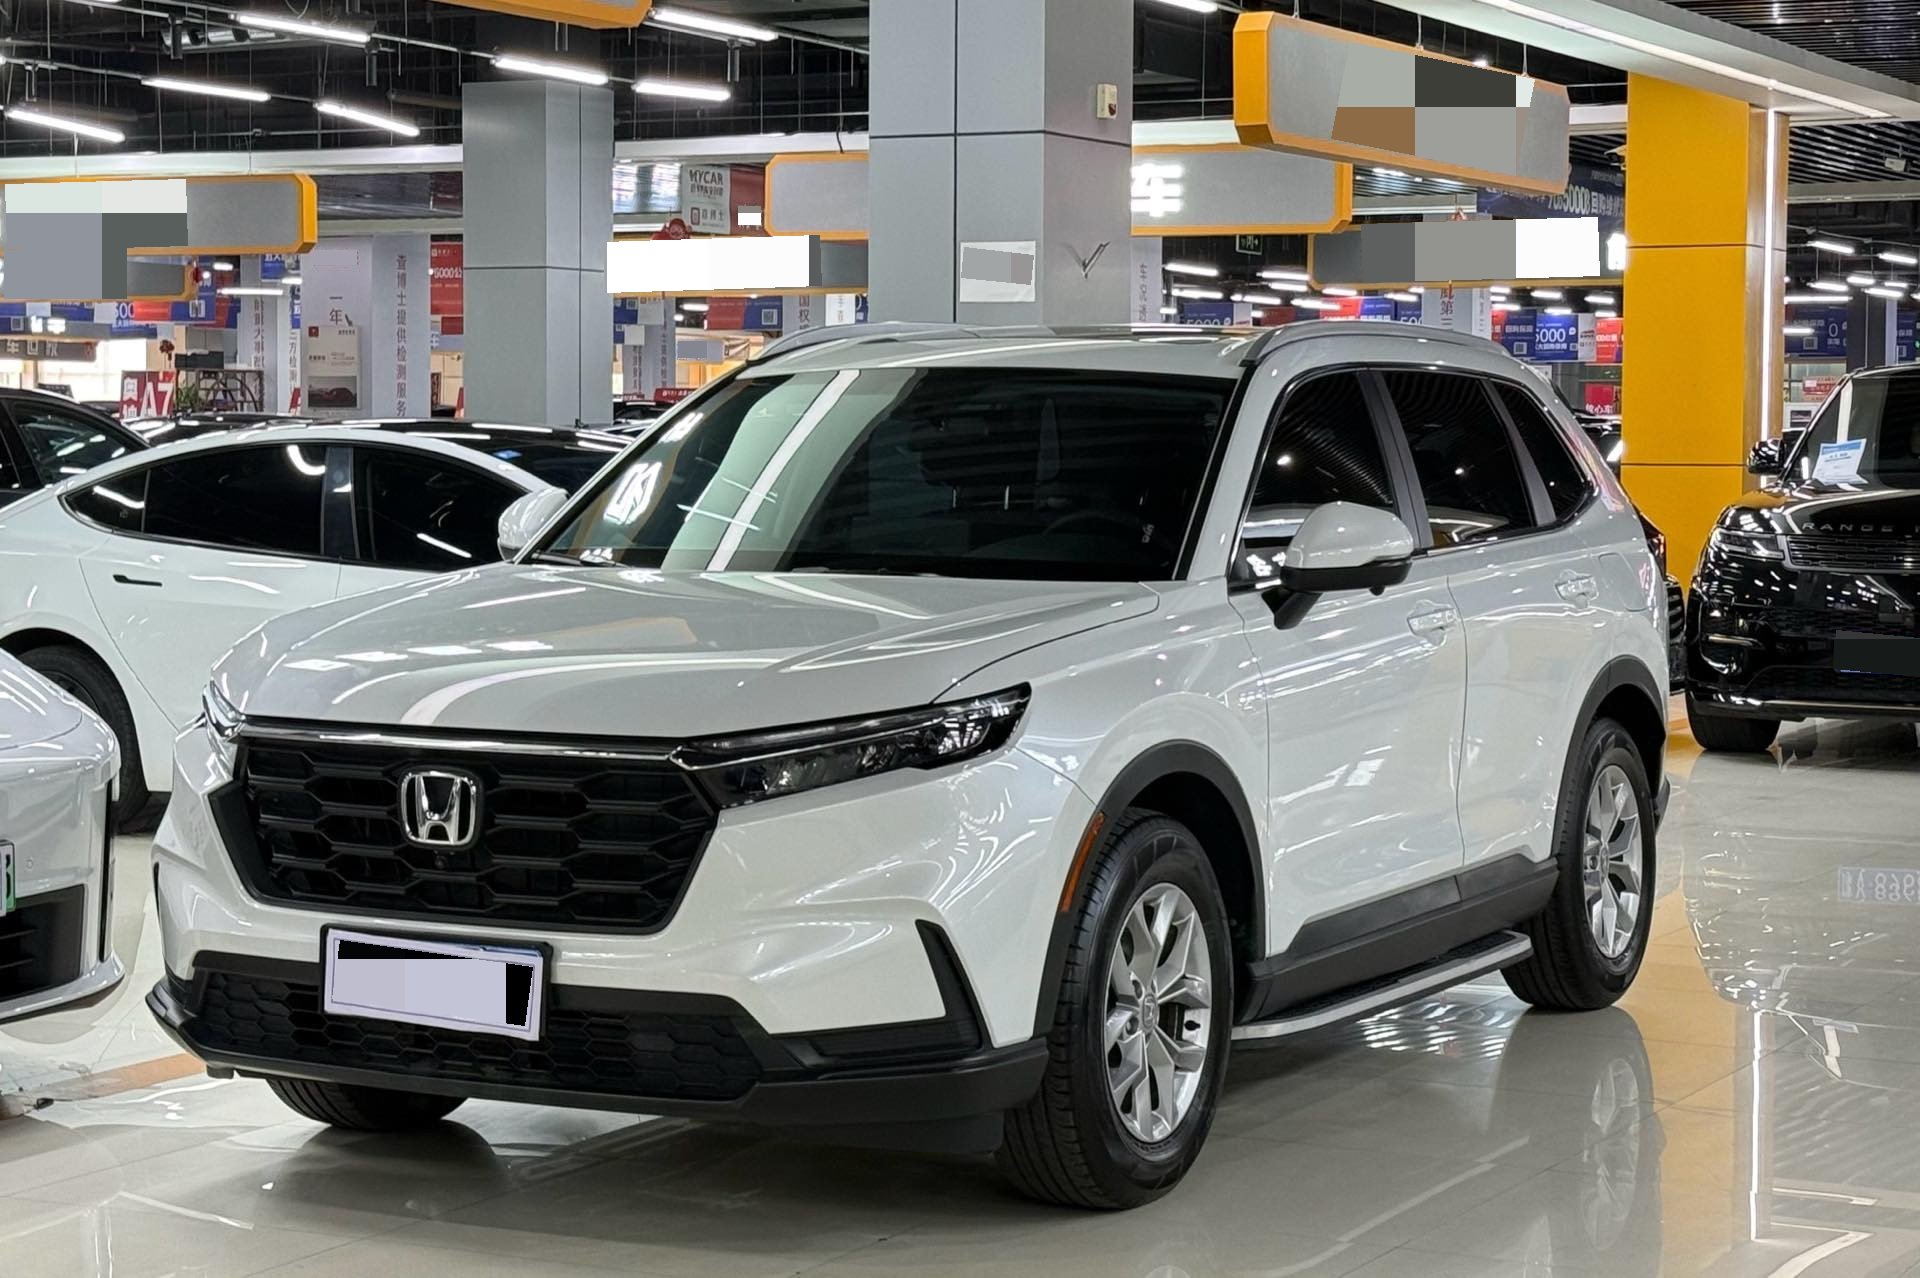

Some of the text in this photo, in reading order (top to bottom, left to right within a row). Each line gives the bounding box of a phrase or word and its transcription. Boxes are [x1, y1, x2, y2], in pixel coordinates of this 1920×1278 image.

[689, 169, 723, 185] MYCAR
[140, 381, 174, 417] A7
[1802, 522, 1894, 533] RANGE
